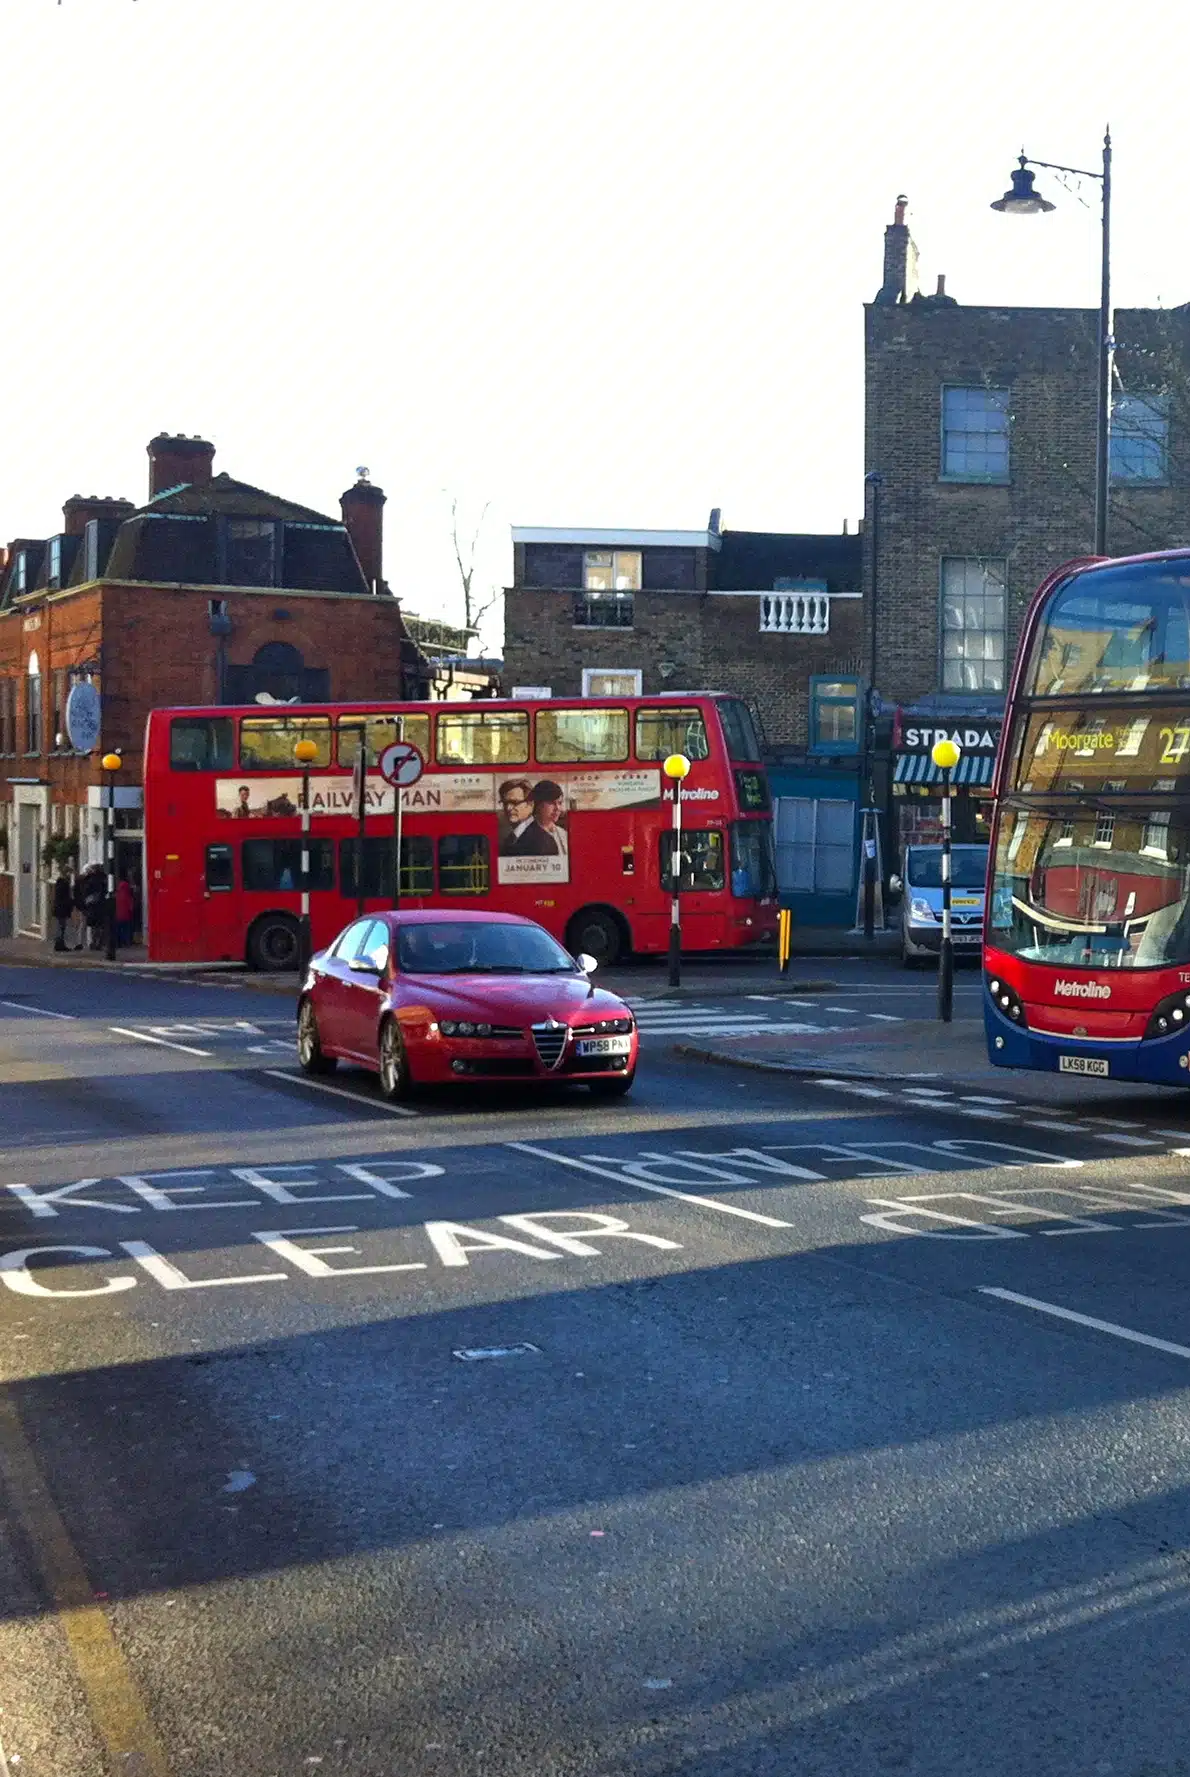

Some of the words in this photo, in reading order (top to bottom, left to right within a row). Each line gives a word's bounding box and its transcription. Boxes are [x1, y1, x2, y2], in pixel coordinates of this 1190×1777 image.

[906, 728, 994, 748] STRADA
[1047, 728, 1114, 750] Moorgate
[506, 863, 547, 872] JANUARY
[1054, 979, 1112, 999] Metroline
[582, 1039, 610, 1053] WP58
[1062, 1057, 1086, 1071] LK58
[1087, 1060, 1105, 1073] KGG
[580, 1140, 1085, 1186] CLEAR
[6, 1160, 446, 1217] KEEP
[0, 1211, 684, 1298] CLEAR
